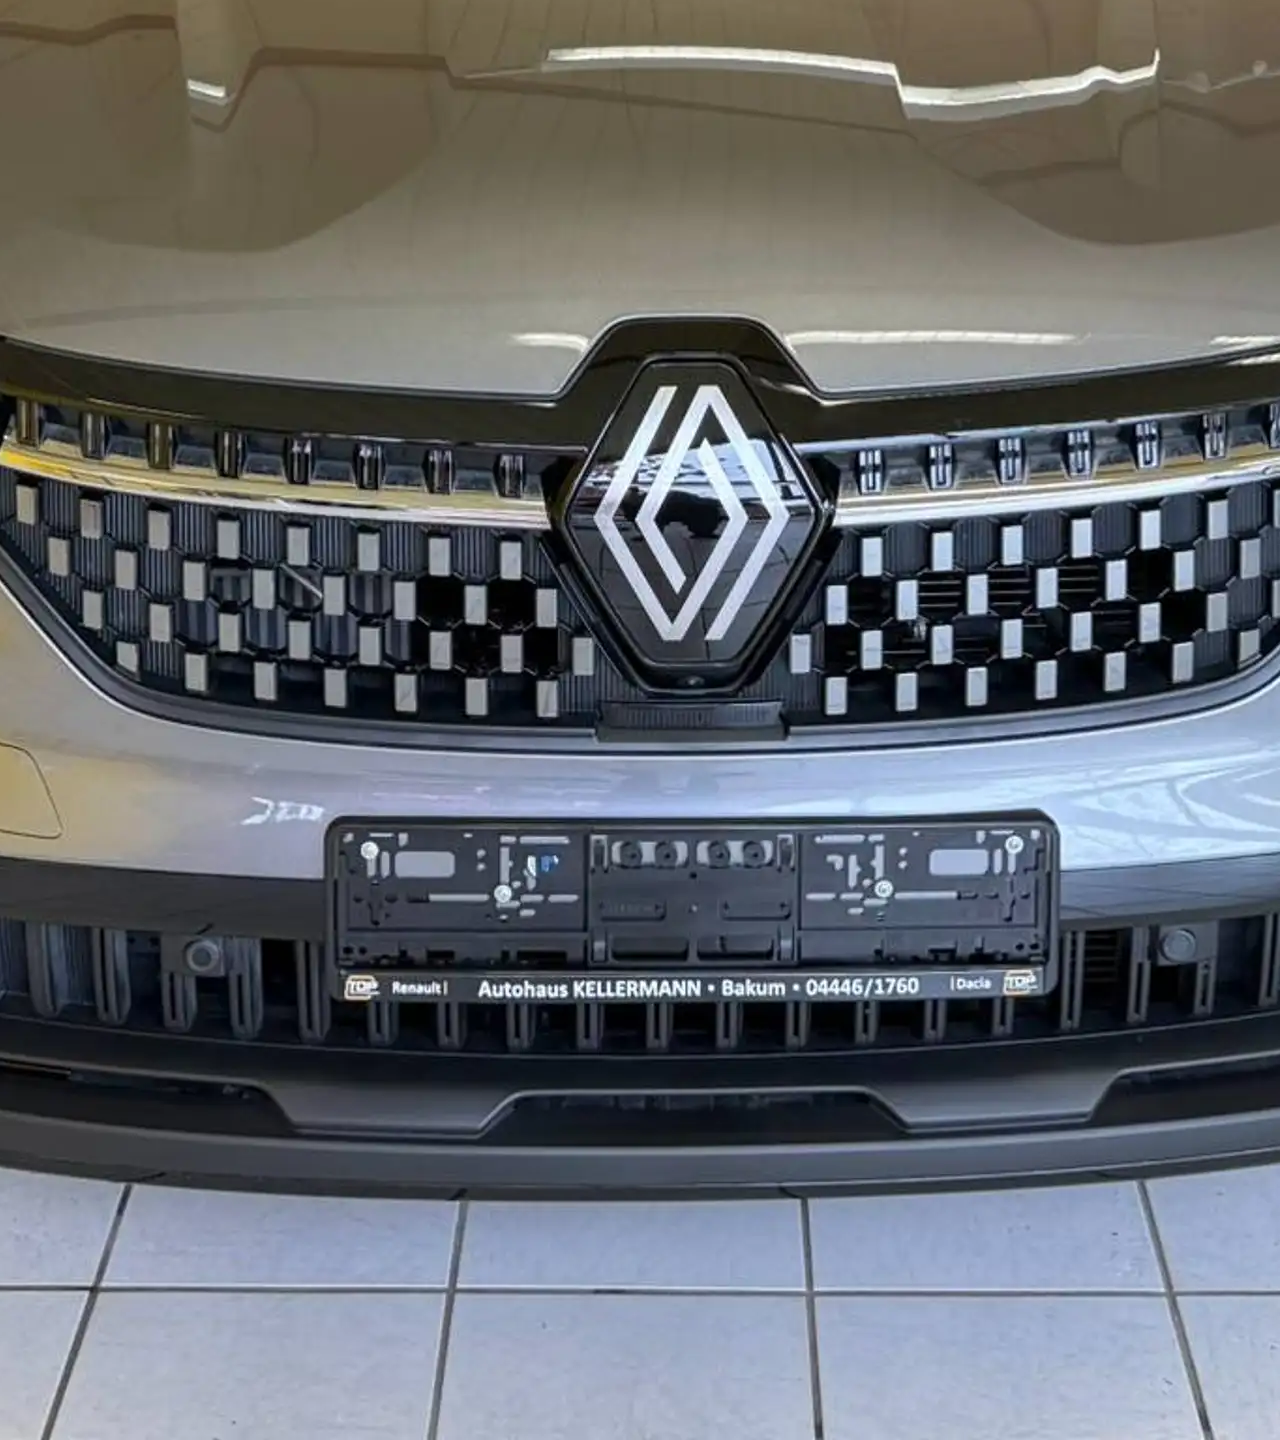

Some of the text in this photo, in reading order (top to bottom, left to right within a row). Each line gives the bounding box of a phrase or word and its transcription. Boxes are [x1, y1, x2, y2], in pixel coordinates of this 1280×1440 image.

[391, 980, 442, 995] Renault
[478, 980, 568, 998] Autohaus
[573, 980, 701, 998] KELLERMANN
[721, 978, 786, 997] Bakum
[805, 977, 919, 999] 04446/1760
[956, 975, 992, 990] Dacia
